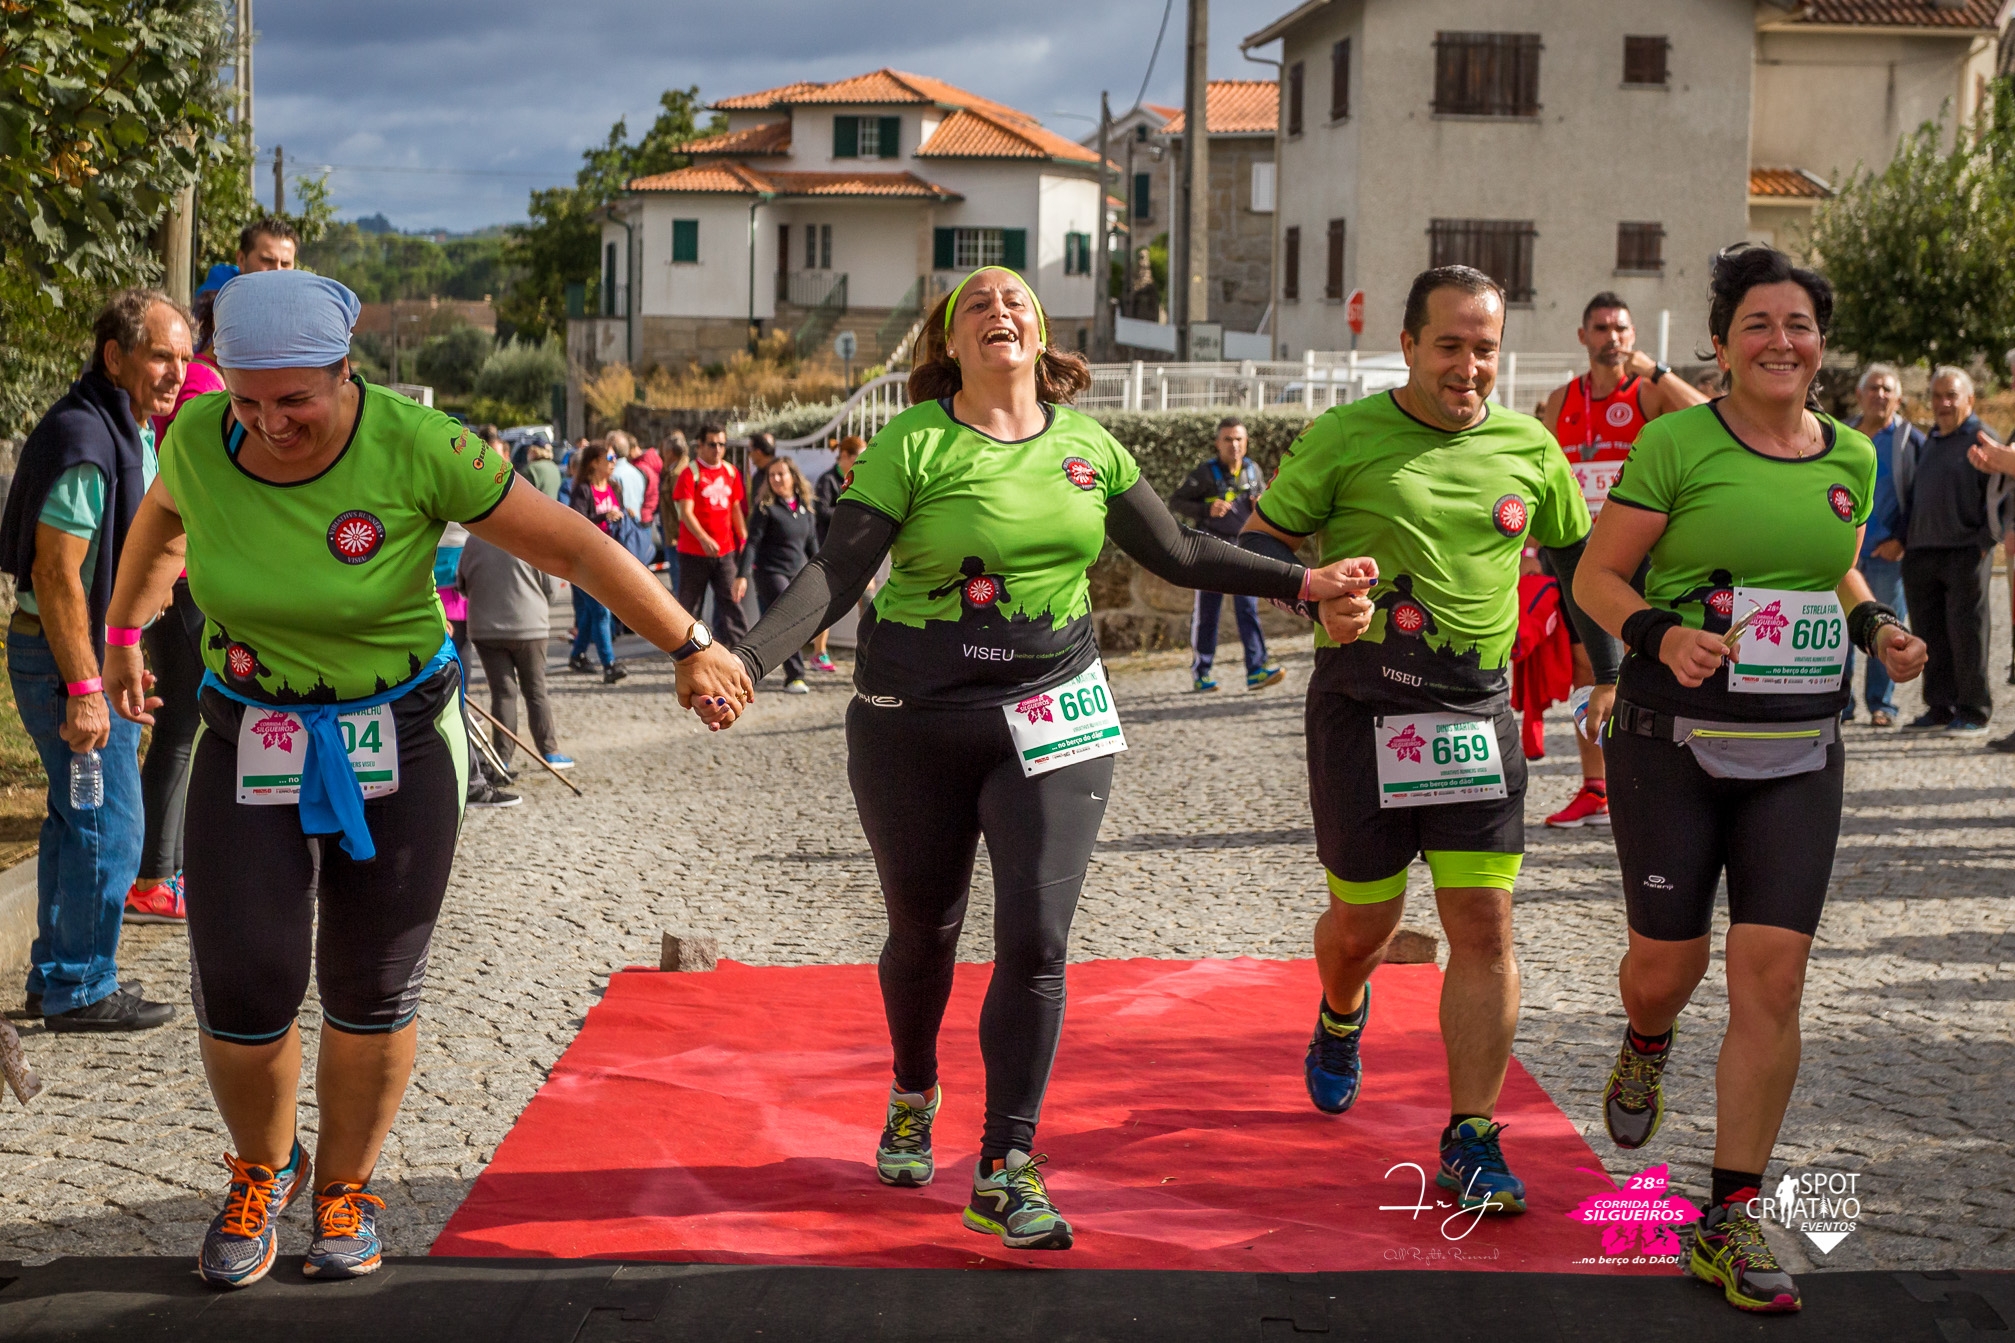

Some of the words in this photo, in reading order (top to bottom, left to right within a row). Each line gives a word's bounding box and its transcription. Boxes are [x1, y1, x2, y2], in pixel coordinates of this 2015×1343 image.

[1802, 605, 1826, 615] ESTRELA
[1791, 618, 1842, 650] 603
[962, 643, 1015, 662] VISEU
[1381, 665, 1423, 687] VISEU
[1782, 667, 1799, 676] berço
[1059, 684, 1108, 721] 660
[256, 725, 294, 733] SILGUEIROS
[1453, 722, 1480, 732] MARTINS
[1066, 737, 1083, 747] berço
[1083, 734, 1092, 742] do
[1432, 734, 1490, 765] 659
[1429, 780, 1449, 788] berço
[1459, 777, 1474, 785] dão!
